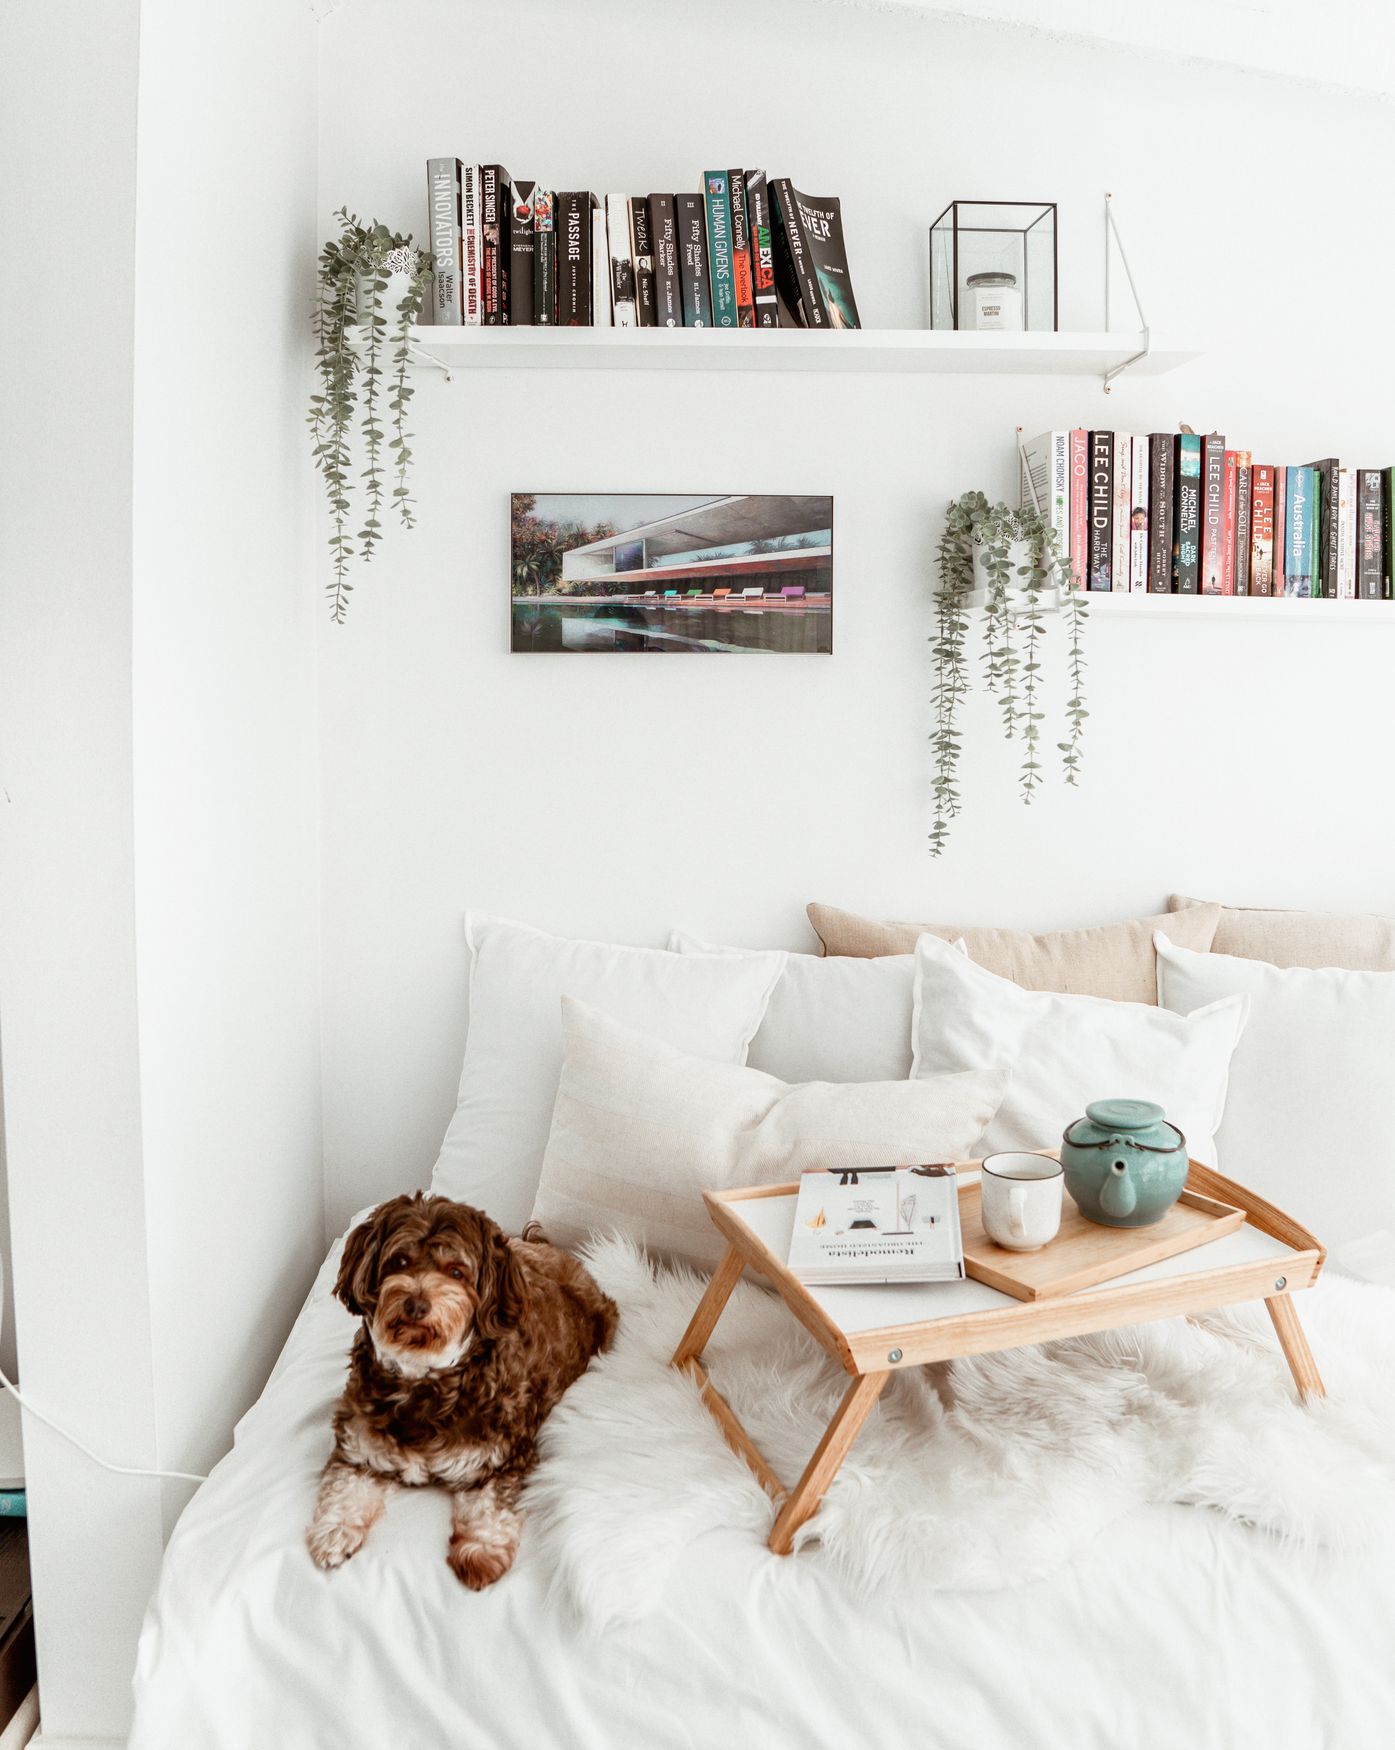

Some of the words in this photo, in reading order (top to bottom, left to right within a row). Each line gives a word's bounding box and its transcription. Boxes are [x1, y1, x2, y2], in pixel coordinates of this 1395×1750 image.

[465, 167, 473, 193] SIMON
[484, 169, 495, 195] PETER
[731, 175, 742, 211] Michael
[434, 174, 454, 267] INNOVATORS
[465, 194, 475, 227] BECKETT
[485, 195, 497, 223] SINGER
[711, 199, 726, 239] HUMAN
[783, 190, 792, 213] TWELFTH
[788, 221, 802, 255] NEVER
[825, 212, 835, 220] OF
[568, 213, 580, 261] PASSAGE
[664, 219, 672, 241] Fifty
[692, 220, 700, 241] Fifty
[734, 214, 744, 250] Connelly
[467, 235, 476, 276] CHEMISTRY
[665, 243, 675, 276] Shades
[686, 243, 694, 266] Freed
[693, 244, 702, 277] Shades
[715, 241, 729, 280] GIVENS
[757, 226, 774, 289] AMEXICA
[438, 271, 446, 309] Isaacson
[445, 275, 454, 303] Walter
[471, 278, 477, 287] OF
[739, 269, 747, 303] Overlook
[468, 288, 477, 315] DEATH
[1055, 436, 1065, 457] NOAM
[1074, 436, 1086, 476] JACO
[1094, 434, 1109, 467] LEE
[1055, 458, 1065, 493] CHOMSKY
[1159, 452, 1167, 489] WIDOW
[1209, 456, 1220, 480] LEE
[1239, 467, 1247, 494] CARE
[1093, 472, 1109, 529] CHILD
[1180, 485, 1189, 534] CONNELLY
[1188, 489, 1197, 530] MICHAEL
[1208, 483, 1220, 525] CHILD
[1055, 516, 1063, 528] AND
[1238, 511, 1246, 537] SOUL
[1254, 499, 1264, 544] CHILD
[1263, 508, 1272, 533] LEE
[1293, 494, 1306, 557] Australia
[1093, 530, 1101, 551] HARD
[1100, 542, 1108, 558] THE
[1261, 583, 1267, 594] GO
[828, 1249, 914, 1257] Remodelista
